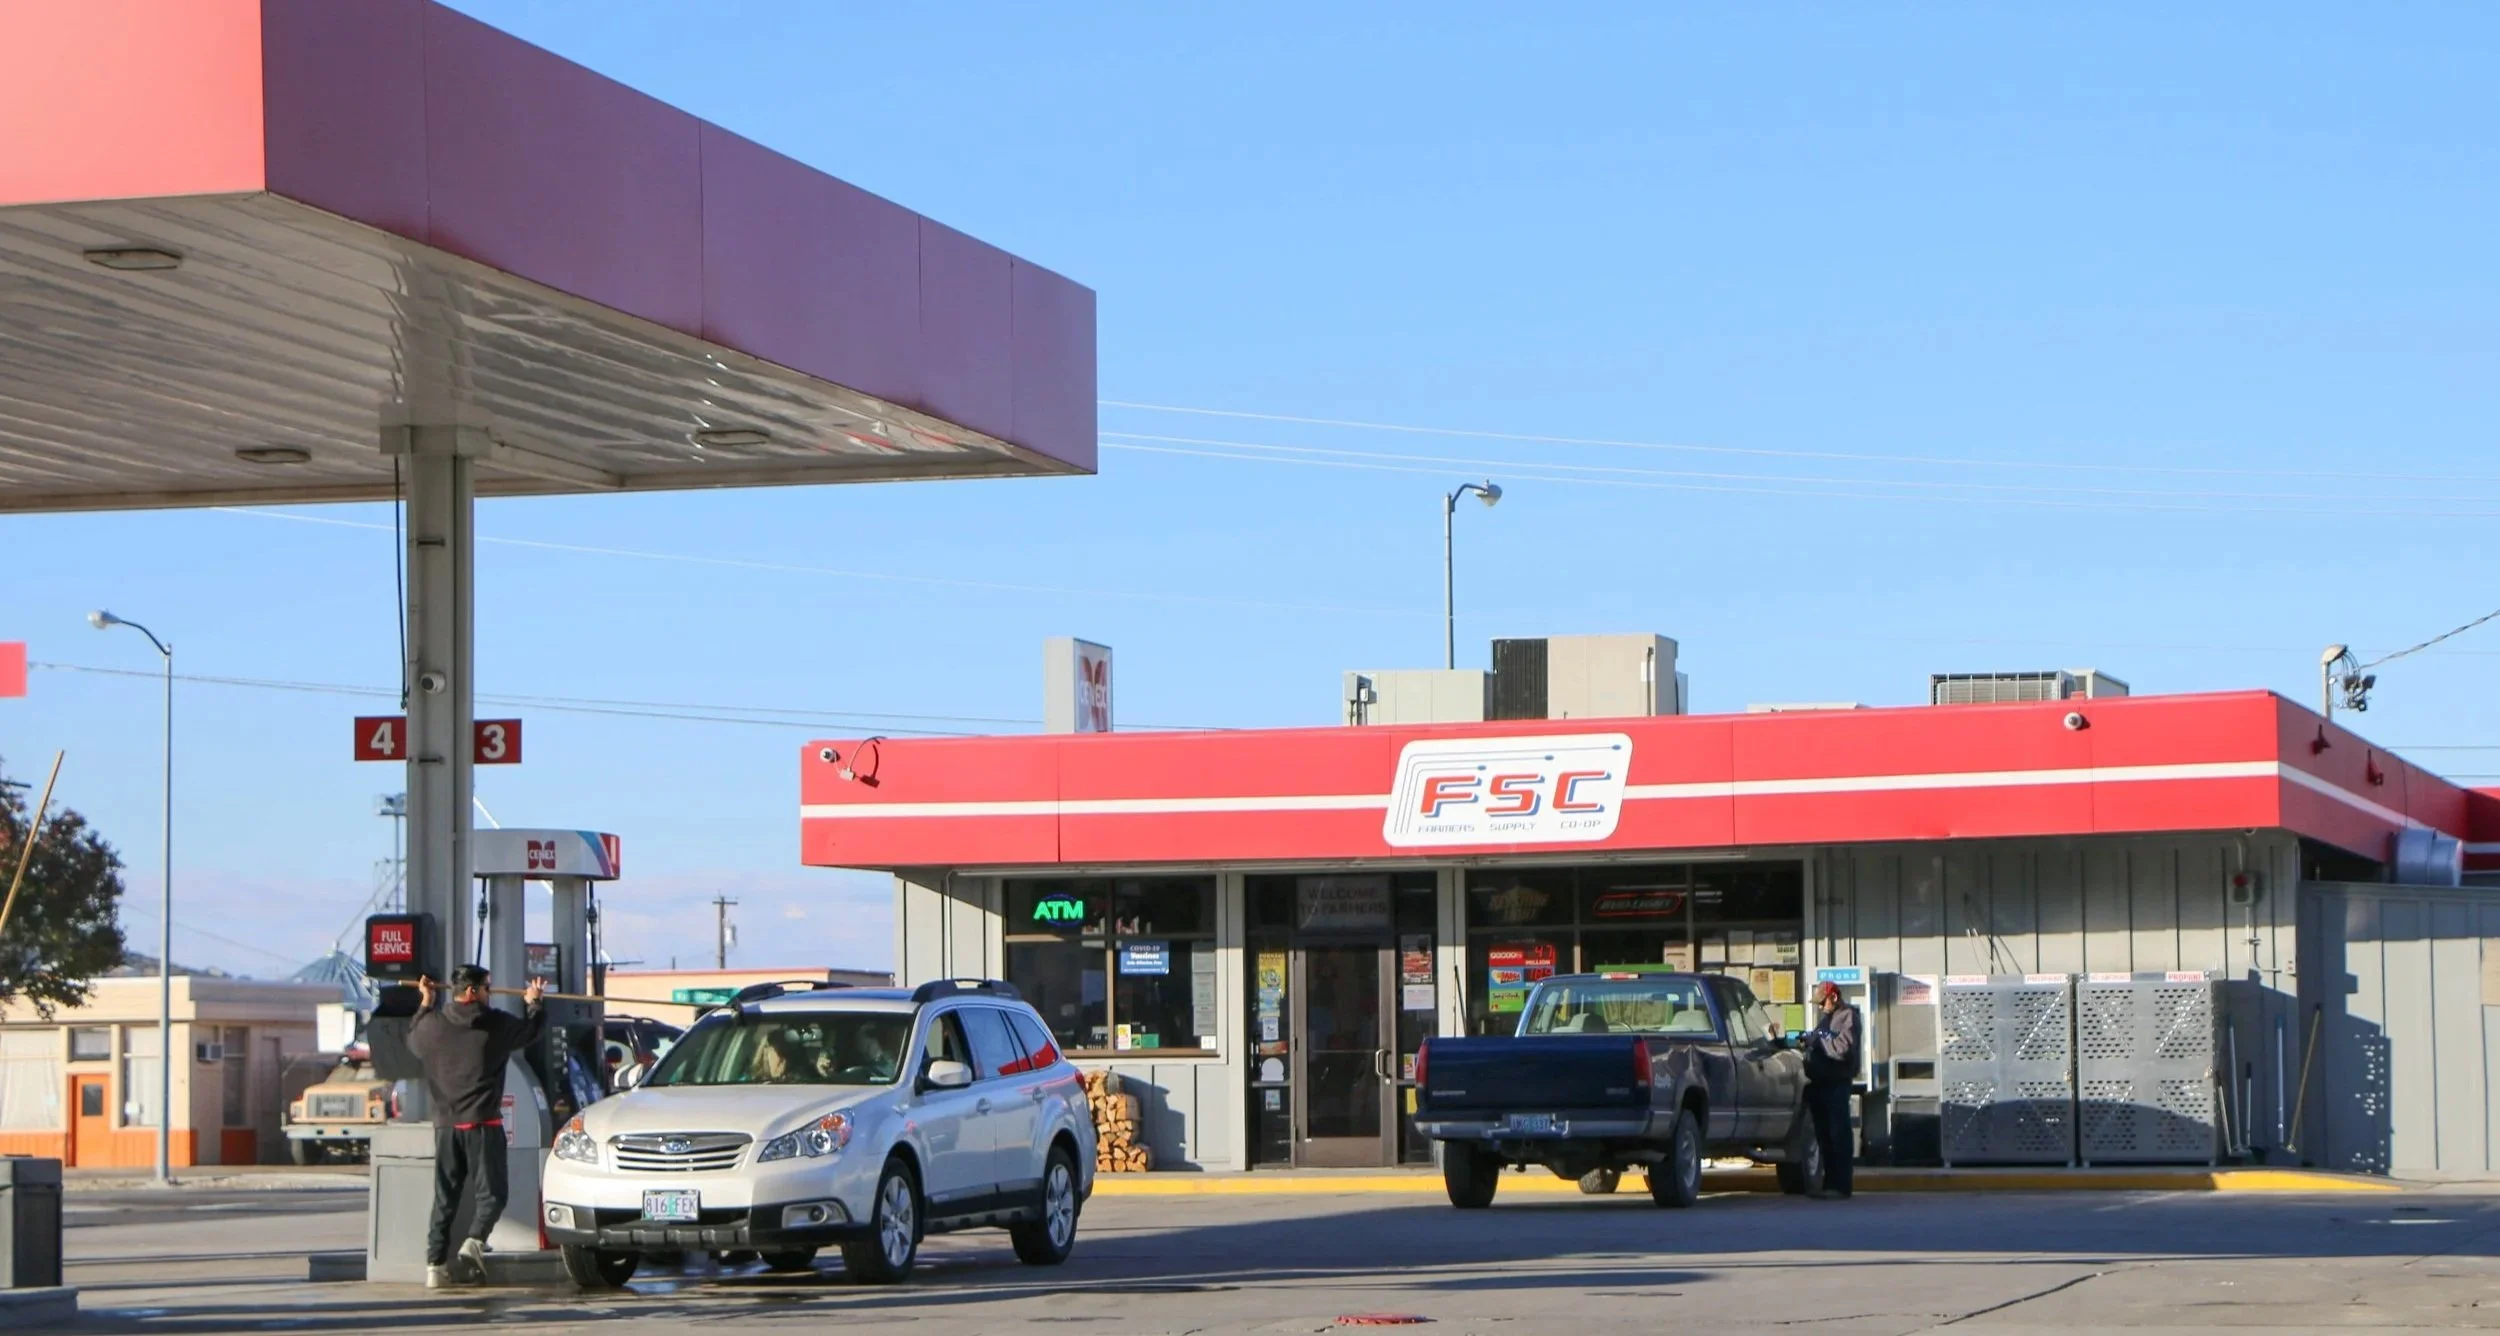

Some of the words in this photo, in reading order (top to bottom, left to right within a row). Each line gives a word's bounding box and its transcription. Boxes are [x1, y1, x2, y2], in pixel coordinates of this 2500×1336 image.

[370, 721, 395, 756] 4
[482, 723, 507, 760] 3
[1420, 769, 1612, 818] FSC
[1417, 823, 1475, 833] FARMERS
[1489, 821, 1537, 832] SUPPLY
[1560, 819, 1601, 829] CO-OP
[528, 848, 556, 861] CENEX
[1033, 900, 1084, 921] ATM
[381, 930, 402, 942] FULL
[373, 942, 411, 955] SERVICE
[1820, 970, 1857, 980] Phone
[645, 1197, 668, 1213] 816
[675, 1197, 698, 1214] FEK
